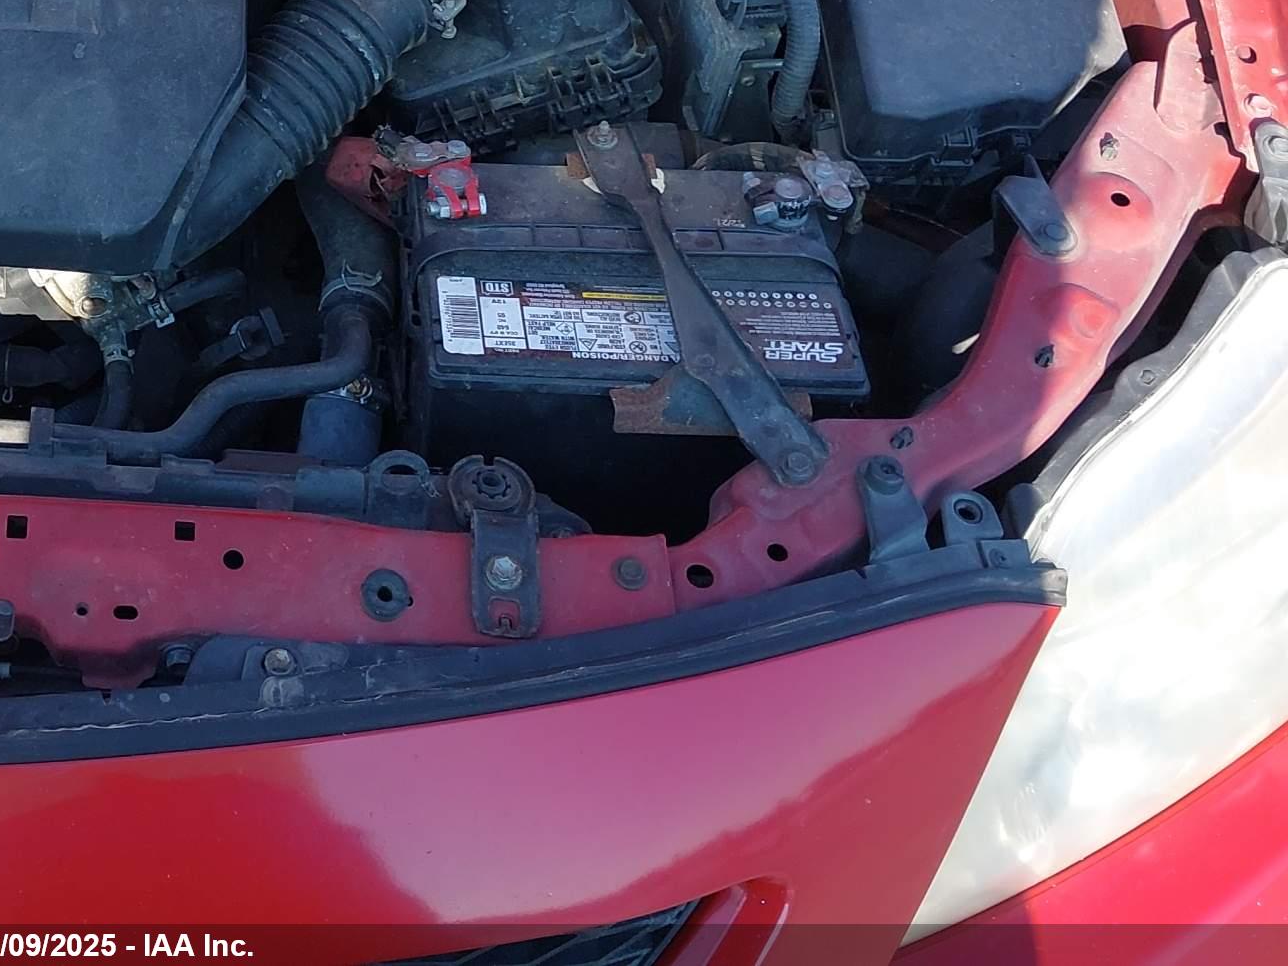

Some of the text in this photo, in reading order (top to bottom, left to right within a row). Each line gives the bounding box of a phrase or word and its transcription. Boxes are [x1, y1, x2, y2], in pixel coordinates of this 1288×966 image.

[763, 341, 844, 355] START
[572, 351, 669, 362] DANGER/POISON
[765, 350, 837, 363] SUPER
